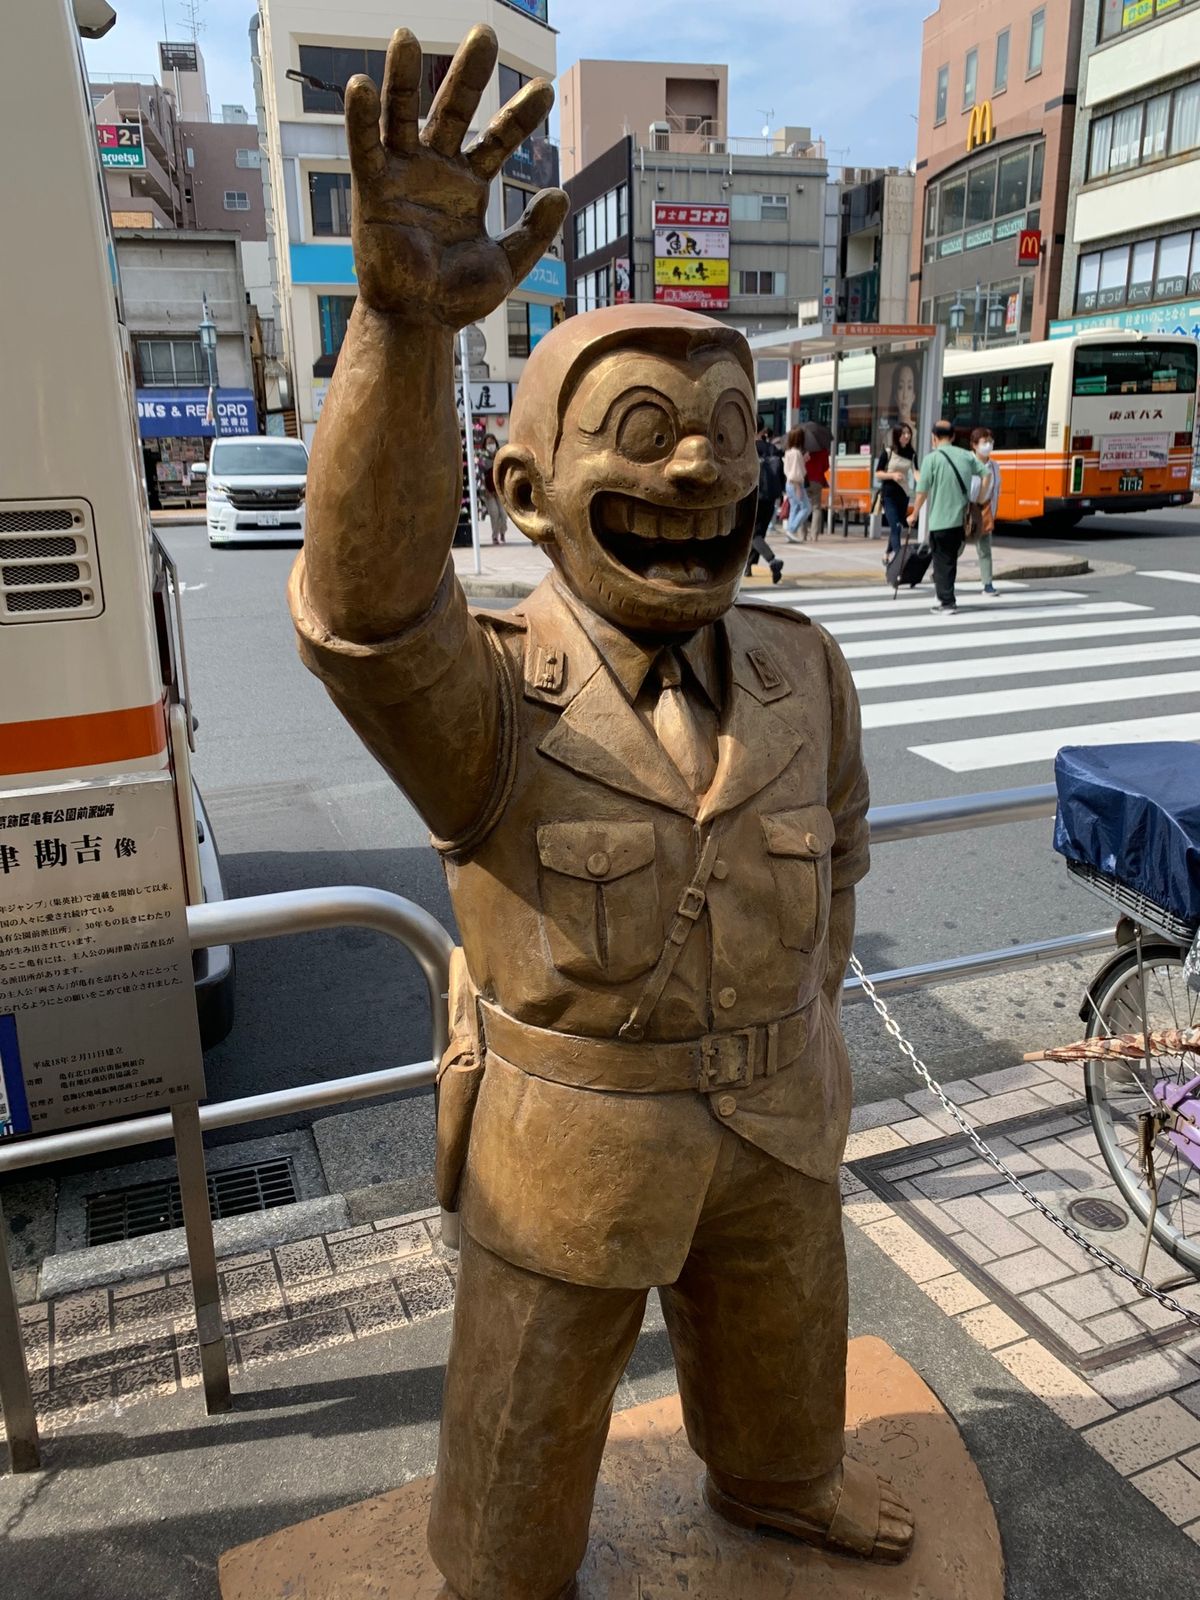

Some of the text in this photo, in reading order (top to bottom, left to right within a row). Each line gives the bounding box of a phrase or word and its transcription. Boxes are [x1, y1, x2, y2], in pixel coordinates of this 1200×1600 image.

[118, 129, 140, 145] 2F
[689, 209, 728, 223] コナカ
[1085, 295, 1096, 307] 2F
[1100, 291, 1122, 304] まつげ
[1129, 286, 1152, 298] パーマ
[1157, 280, 1183, 295] 専門店
[171, 405, 181, 417] &
[186, 403, 247, 417] REORD
[1109, 409, 1163, 421] 東武バス
[114, 837, 138, 859] 像
[0, 905, 115, 929] 国の人々に愛され続けている
[0, 978, 183, 1013] られるようにとの願いをこめて建立されました。
